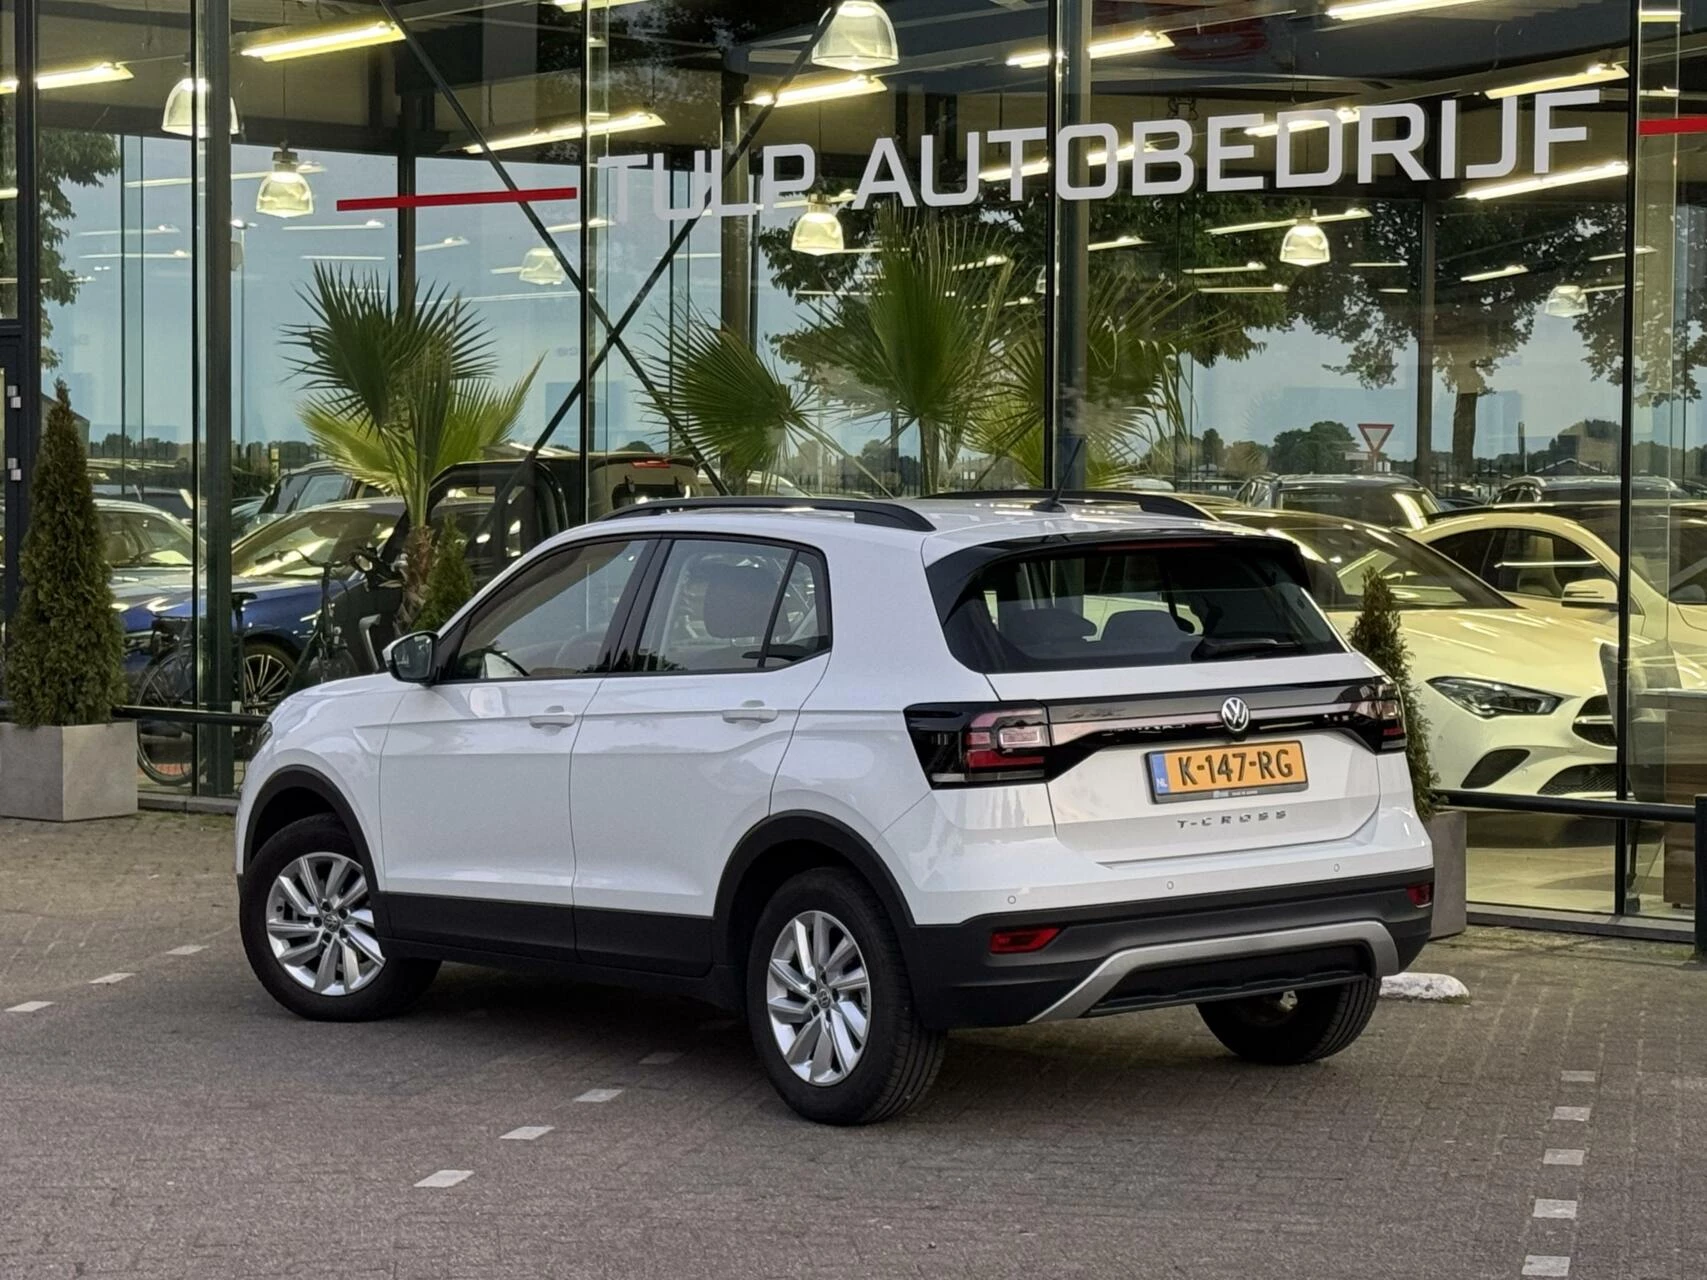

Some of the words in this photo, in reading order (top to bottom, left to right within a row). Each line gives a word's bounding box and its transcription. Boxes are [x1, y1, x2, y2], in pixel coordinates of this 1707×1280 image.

[597, 142, 816, 223] TULP
[850, 90, 1600, 209] AUTOBEDRIJF
[1178, 749, 1293, 786] K-147-RG
[1176, 810, 1287, 829] T-CROSS
